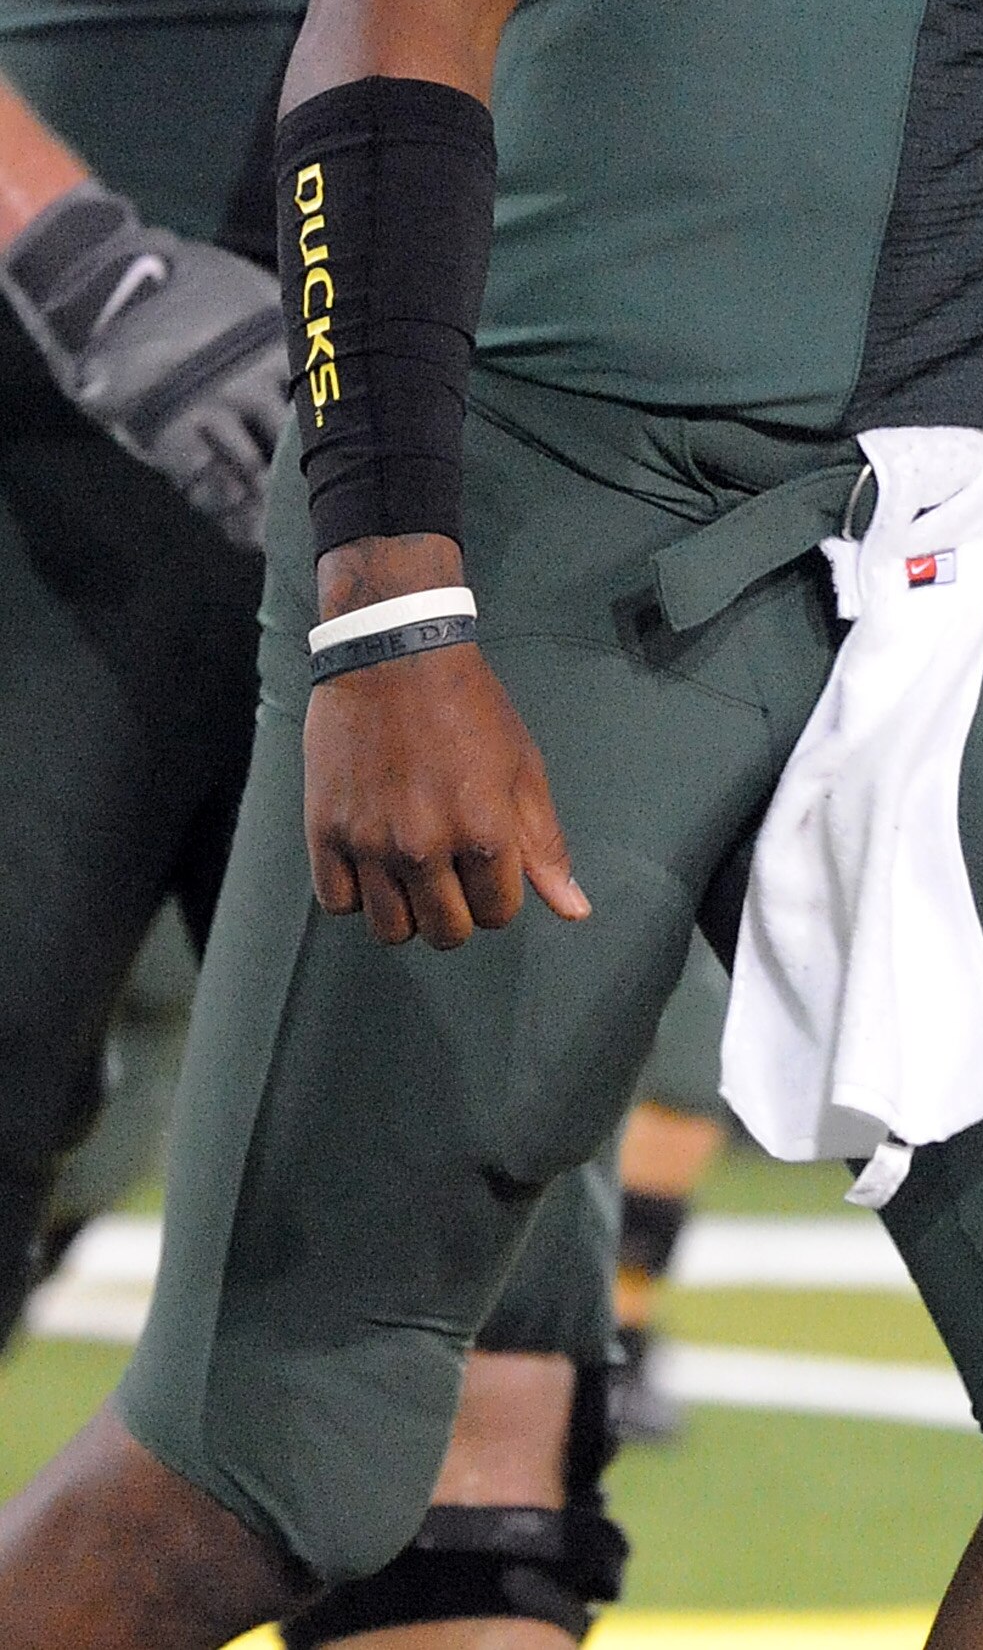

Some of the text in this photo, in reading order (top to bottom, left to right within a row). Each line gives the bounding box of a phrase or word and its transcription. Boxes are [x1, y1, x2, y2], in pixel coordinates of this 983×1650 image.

[294, 162, 341, 408] DUCKS
[347, 631, 407, 660] THE
[418, 618, 467, 644] DAY
